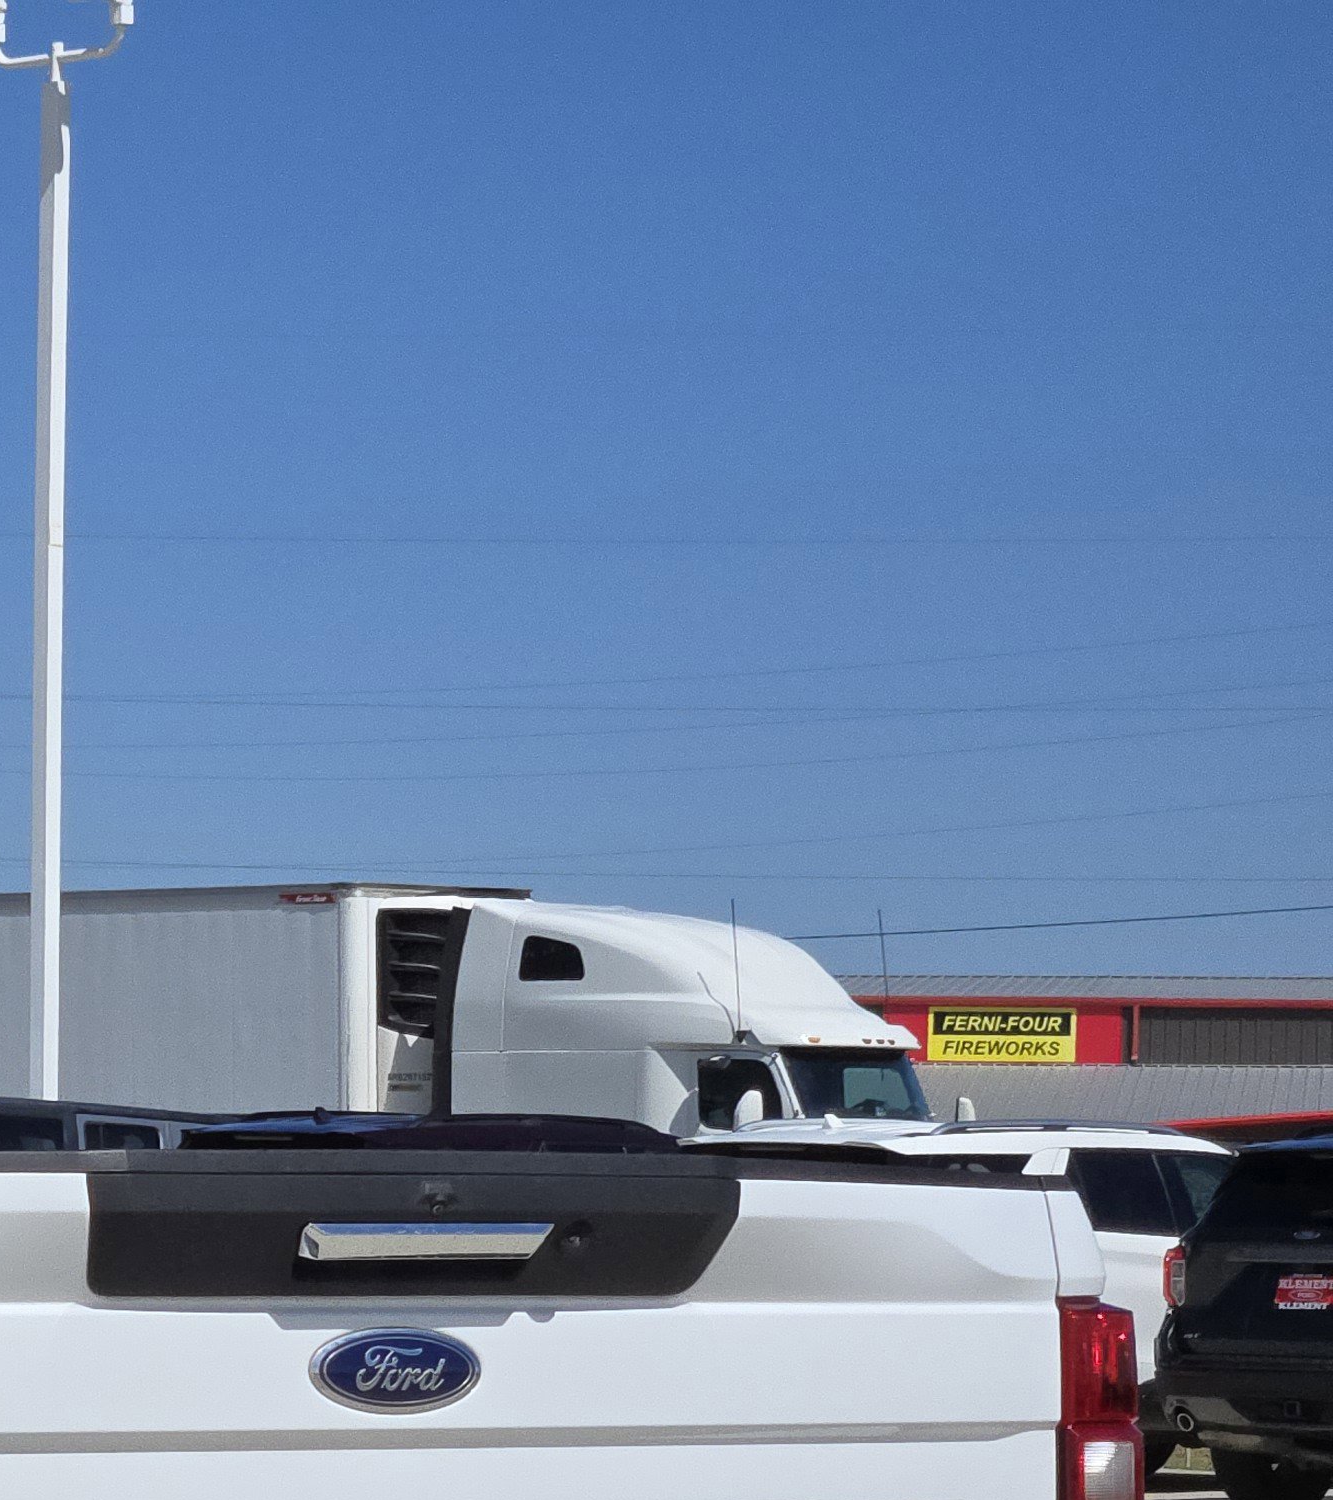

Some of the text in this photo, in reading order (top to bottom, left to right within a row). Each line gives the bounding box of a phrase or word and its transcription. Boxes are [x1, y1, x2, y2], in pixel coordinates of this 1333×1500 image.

[942, 1015, 1063, 1032] FERNI-FOUR
[942, 1040, 1061, 1056] FIREWORKS
[355, 1345, 446, 1392] Ford
